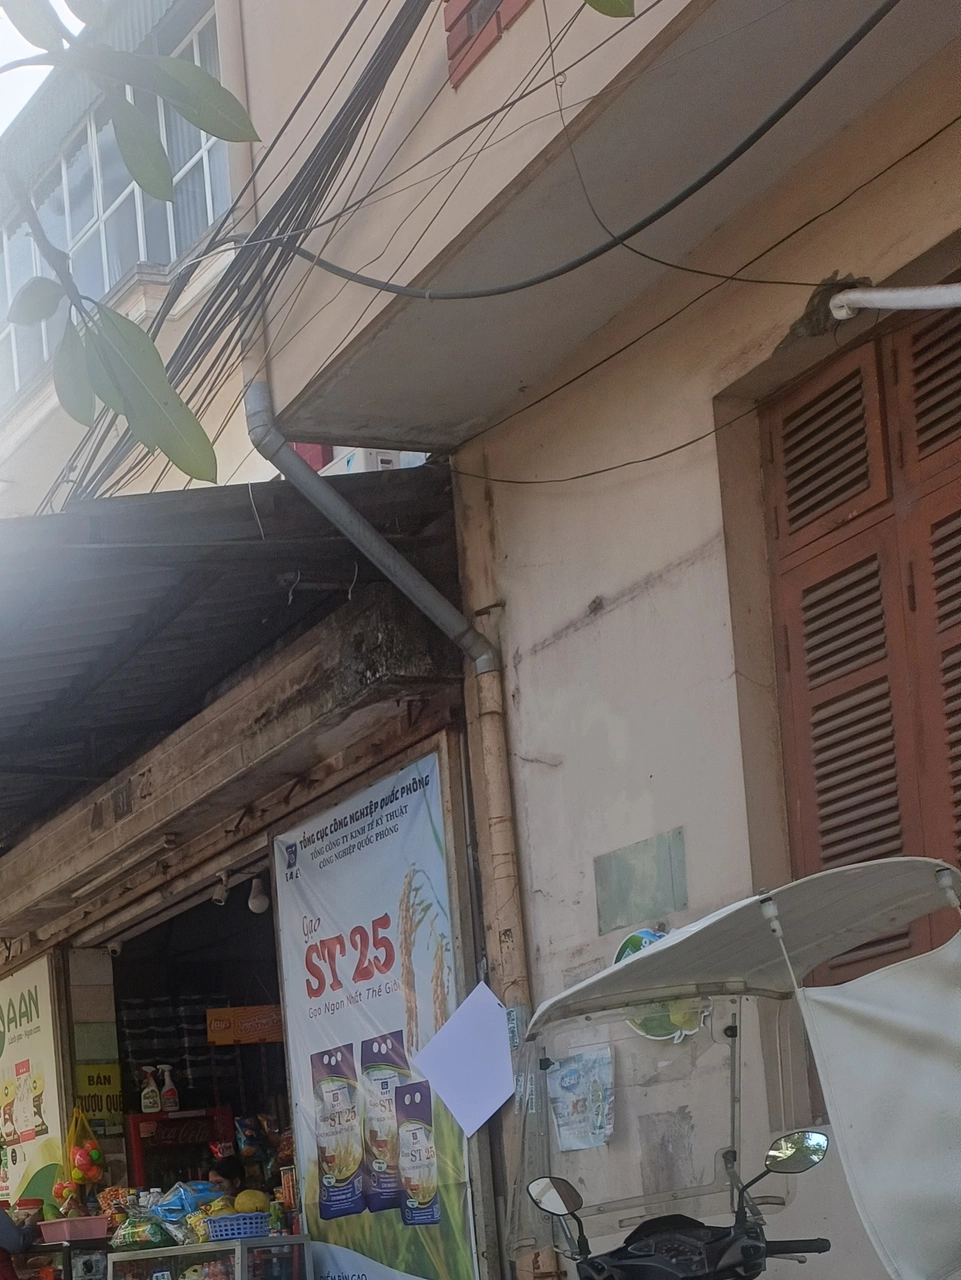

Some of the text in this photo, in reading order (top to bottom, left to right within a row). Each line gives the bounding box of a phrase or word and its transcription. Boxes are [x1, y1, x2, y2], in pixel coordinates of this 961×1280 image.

[299, 831, 315, 850] TỔNG
[316, 826, 329, 843] CỤC
[329, 818, 349, 834] CÔNG
[349, 801, 379, 824] NGHIỆP
[380, 786, 400, 809] QUỐC
[325, 839, 341, 854] CÔNG
[341, 834, 350, 846] TY
[349, 826, 366, 842] KINH
[367, 820, 376, 834] TẾ
[385, 804, 409, 822] THUẬT
[318, 823, 400, 870] CÔNG NGHIỆP QUỐC PHÒNG
[304, 912, 396, 999] ST 25
[7, 985, 39, 1033] AAN
[309, 1007, 322, 1020] Gạo
[324, 1000, 345, 1015] Ngon
[346, 990, 363, 1006] Nhất
[366, 984, 383, 1000] Thế
[87, 1072, 112, 1086] BÁN
[329, 1110, 342, 1128] ST
[345, 1106, 357, 1123] 25
[410, 1148, 424, 1163] ST
[424, 1146, 436, 1161] 25
